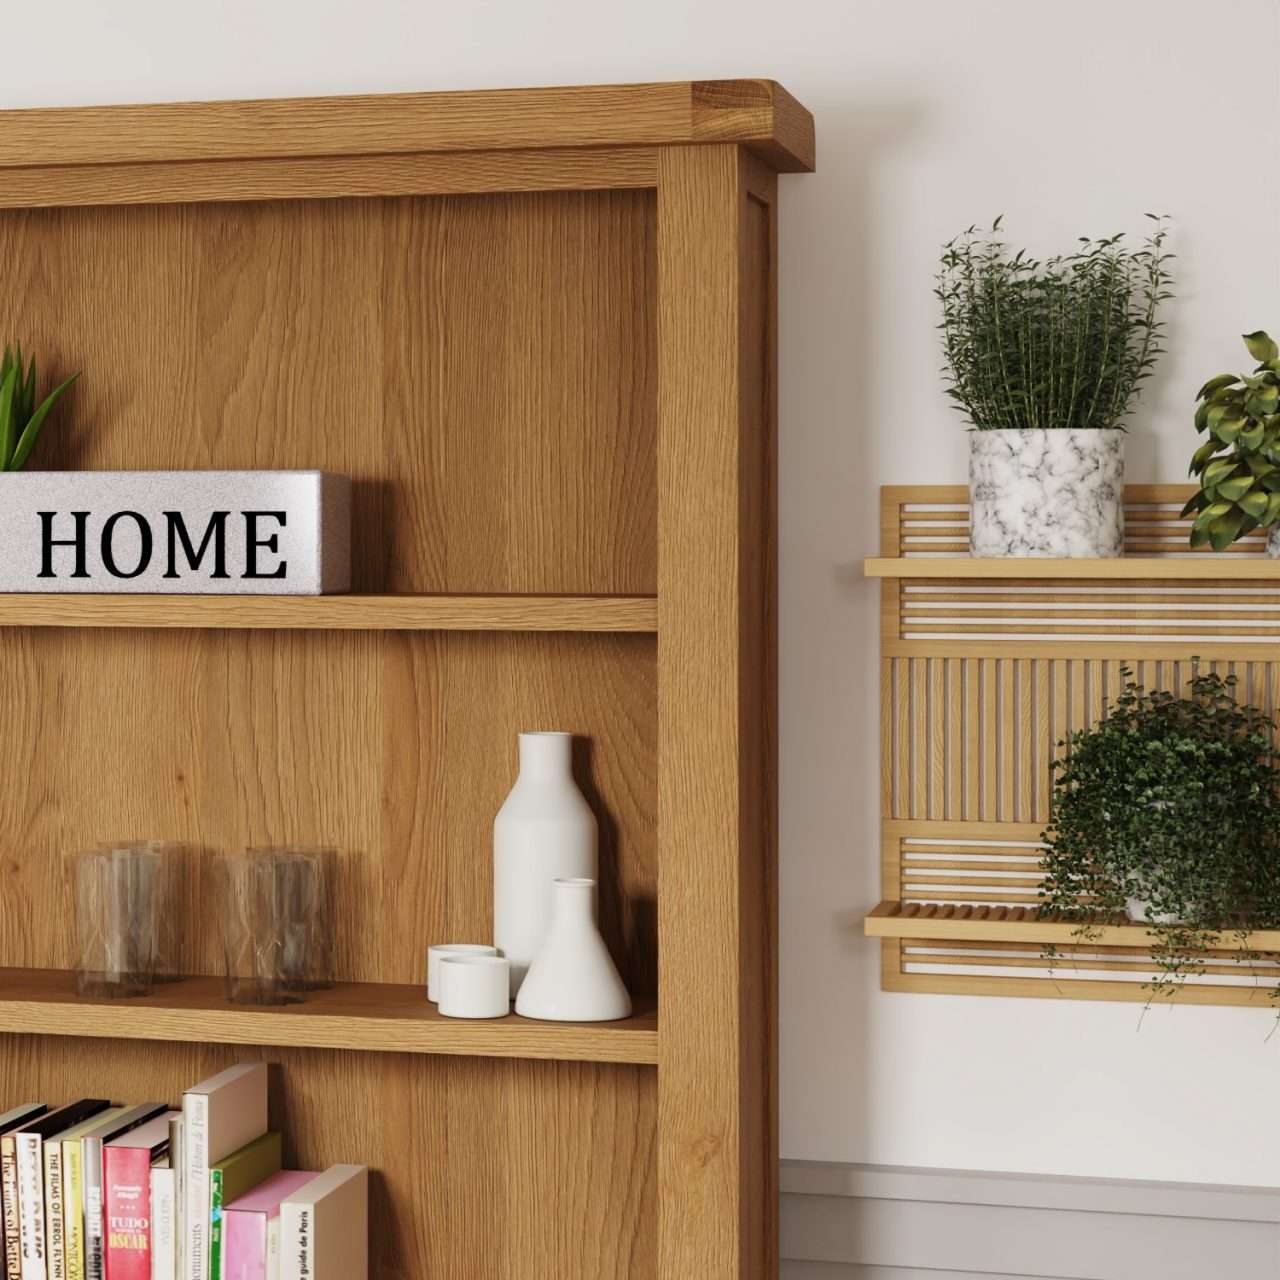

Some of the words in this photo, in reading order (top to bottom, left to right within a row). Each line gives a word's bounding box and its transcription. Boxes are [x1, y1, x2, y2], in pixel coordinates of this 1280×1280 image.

[36, 509, 288, 580] HOME
[2, 1152, 16, 1177] The
[49, 1153, 59, 1170] THE
[50, 1173, 60, 1200] FILMS
[51, 1202, 61, 1215] OF
[5, 1219, 18, 1232] of
[52, 1217, 62, 1245] ERROL
[110, 1216, 148, 1229] TUDO
[298, 1210, 309, 1233] Paris
[7, 1235, 21, 1270] Bette
[110, 1232, 148, 1249] OSCAR
[298, 1235, 308, 1247] de
[53, 1248, 63, 1278] FLYNN
[297, 1249, 309, 1275] guide
